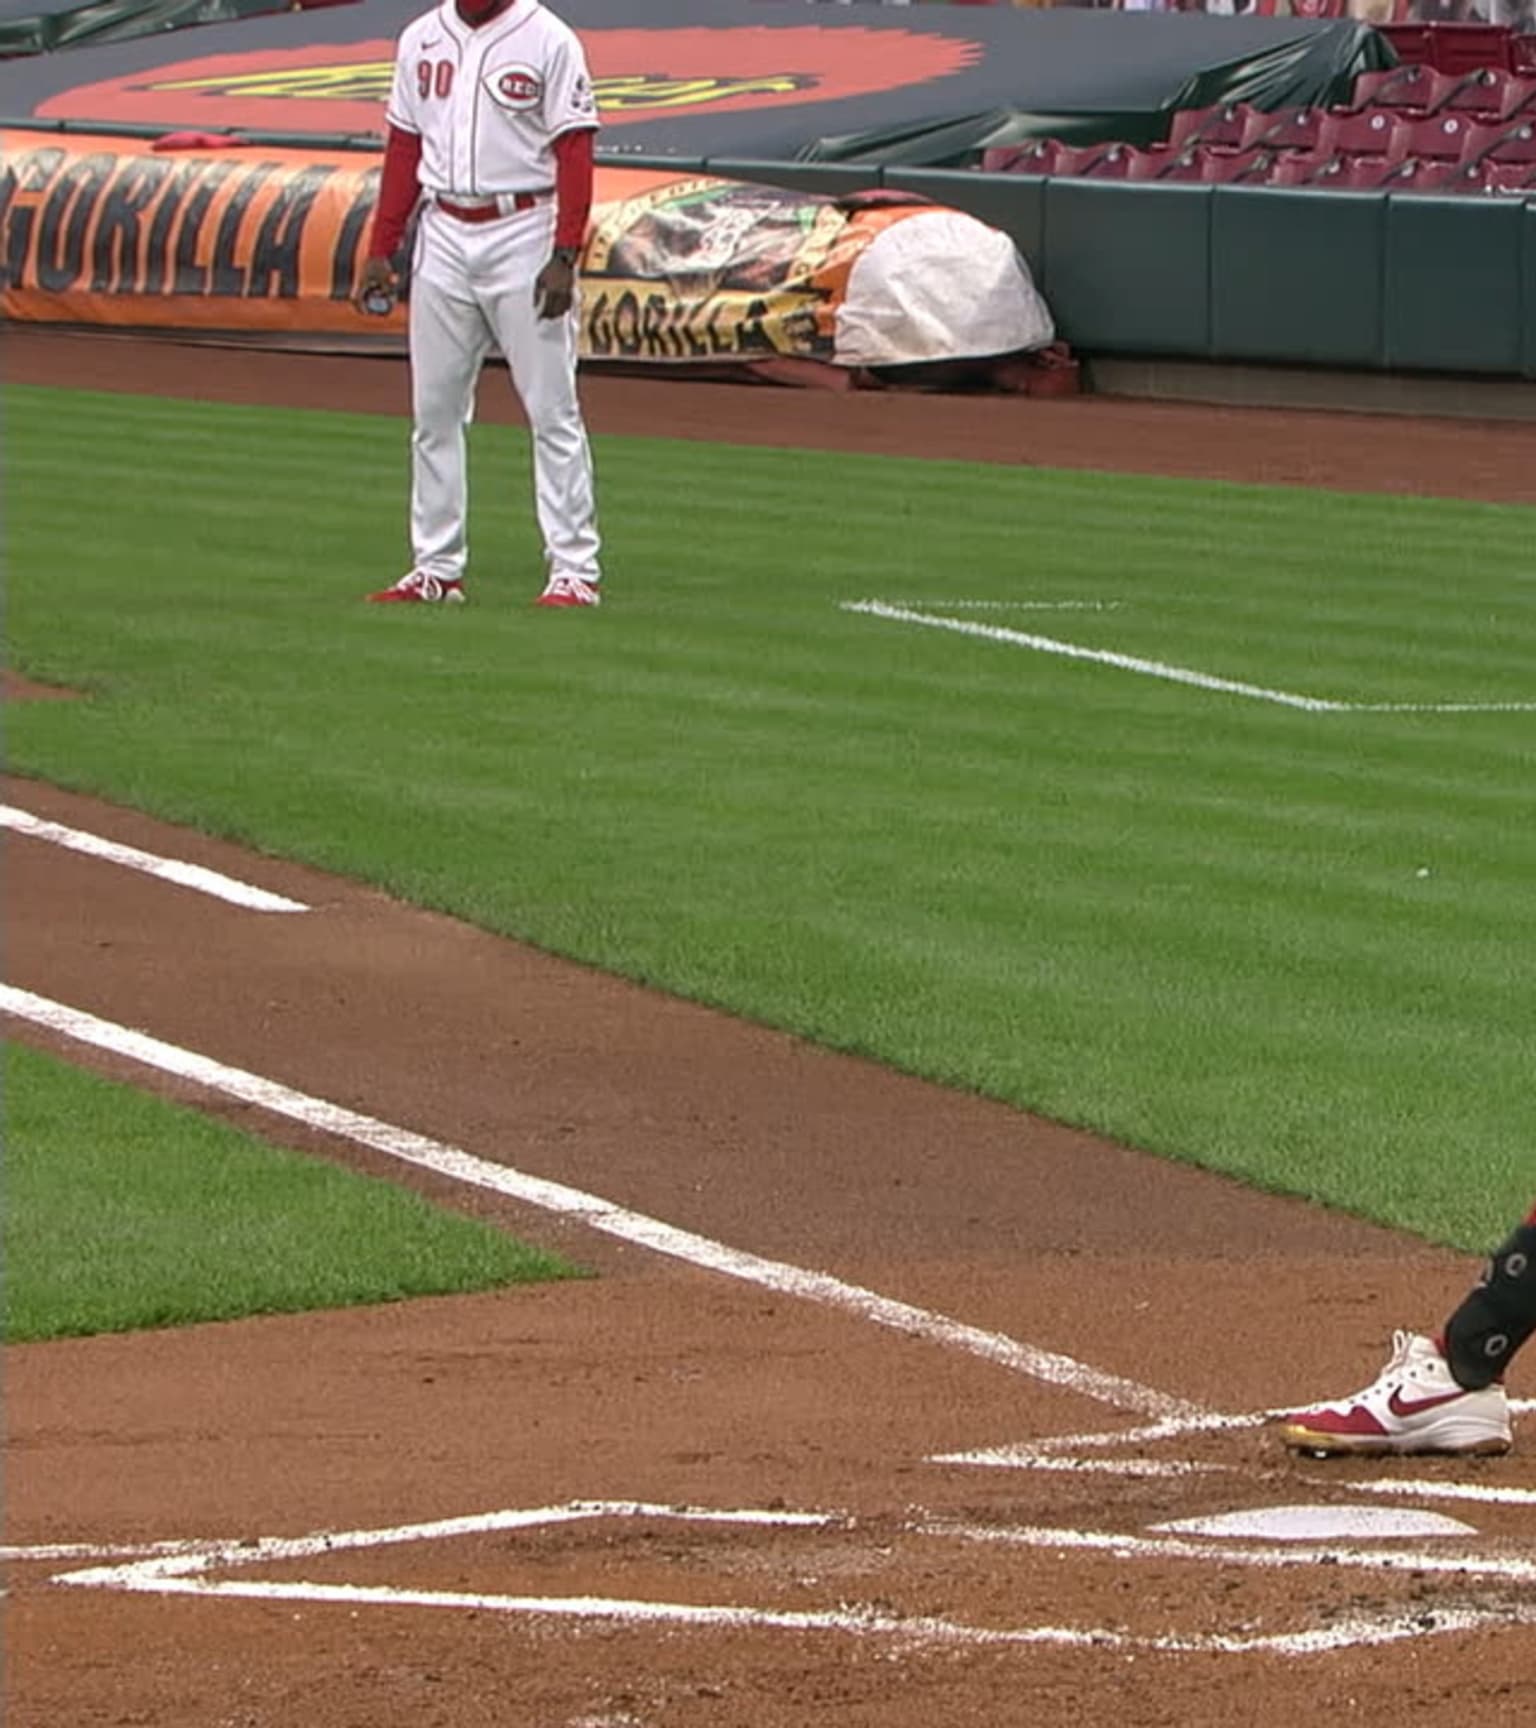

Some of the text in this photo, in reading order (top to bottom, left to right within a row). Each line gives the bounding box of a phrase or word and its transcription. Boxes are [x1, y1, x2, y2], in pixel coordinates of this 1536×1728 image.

[417, 59, 454, 99] 90
[0, 147, 340, 298] GORILLA
[587, 289, 779, 354] GORILLA
